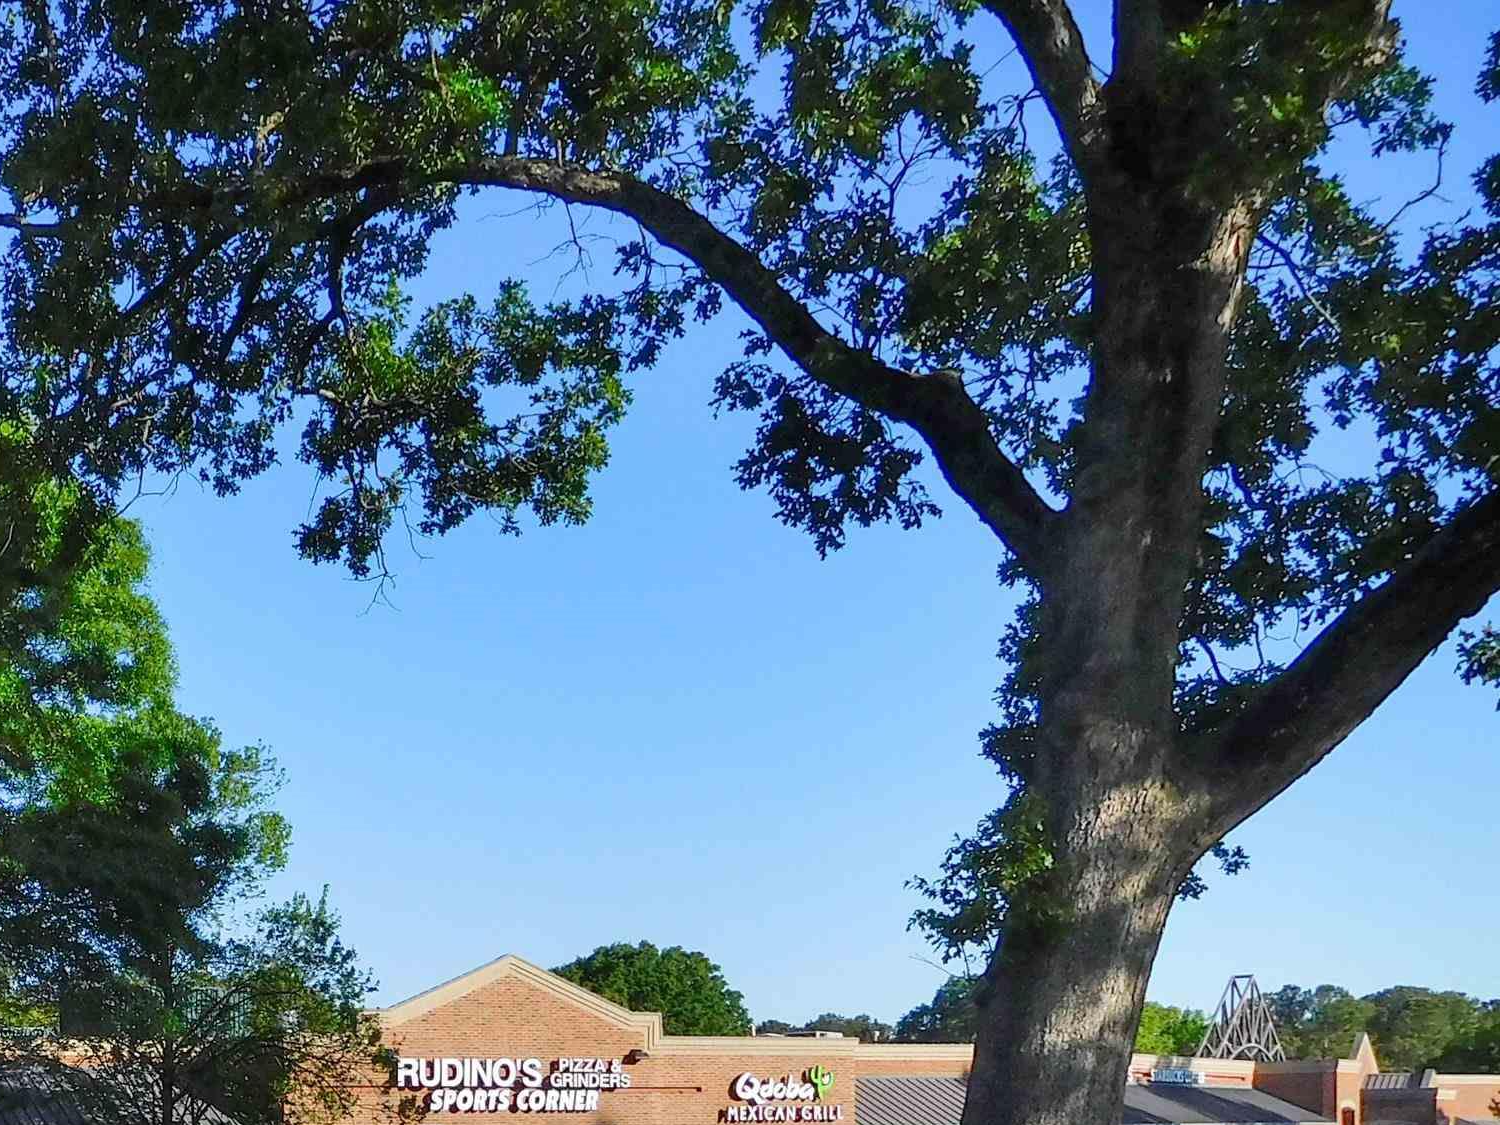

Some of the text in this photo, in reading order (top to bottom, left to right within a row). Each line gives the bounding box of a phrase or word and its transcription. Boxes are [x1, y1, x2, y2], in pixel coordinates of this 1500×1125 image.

[398, 1057, 542, 1087] RUDINO'S
[559, 1058, 622, 1073] PIZZA &
[550, 1073, 631, 1088] GRINDERS
[736, 1072, 815, 1104] Qdoba
[430, 1088, 600, 1111] SPORTS CORNER
[727, 1104, 844, 1121] MEXICAN GRILL
